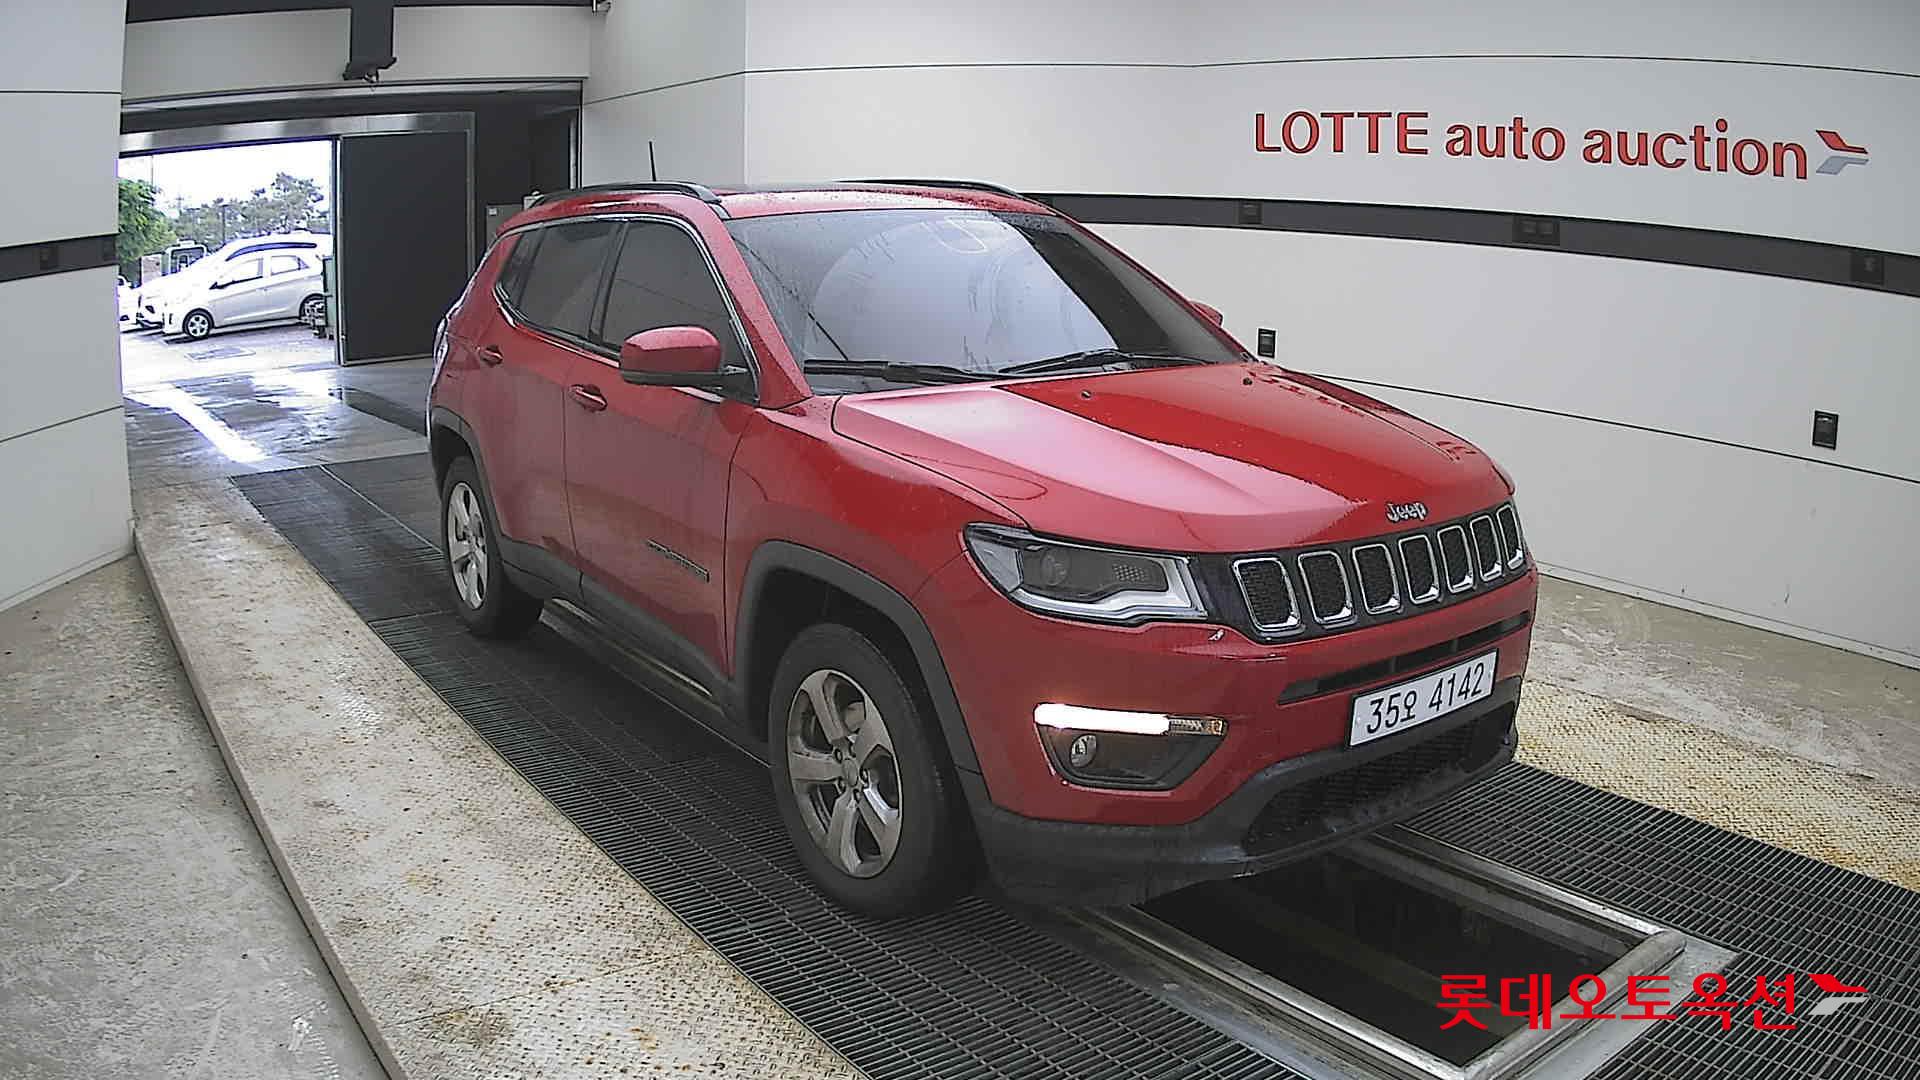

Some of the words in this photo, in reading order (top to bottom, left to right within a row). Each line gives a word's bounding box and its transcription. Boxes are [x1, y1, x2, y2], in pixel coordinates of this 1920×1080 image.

[1254, 111, 1430, 155] LOTTE
[1444, 116, 1567, 162] auto
[1583, 118, 1809, 180] auction
[1386, 502, 1428, 522] Jeep
[1366, 690, 1418, 735] 35오
[1428, 662, 1485, 712] 4142
